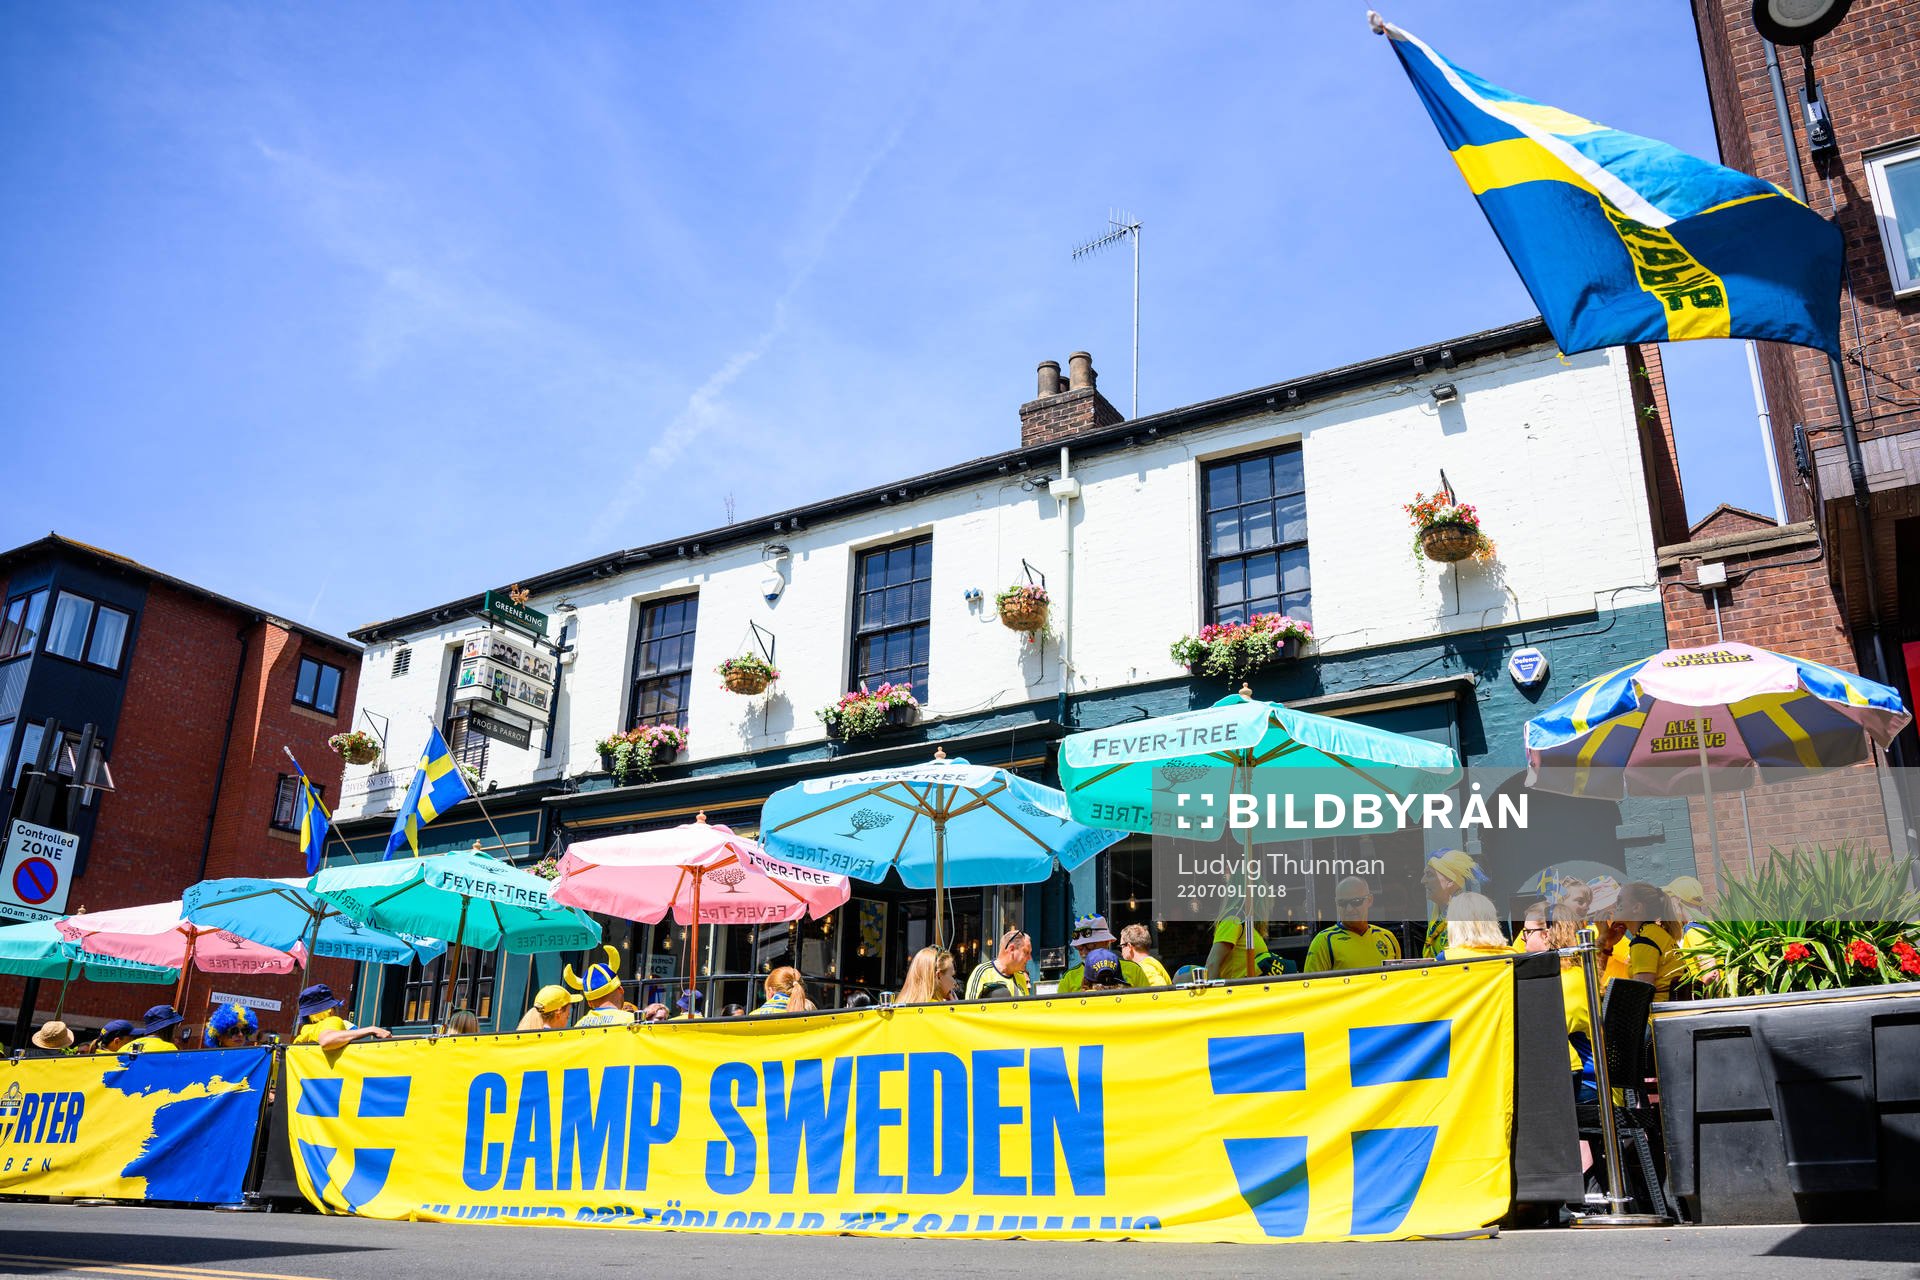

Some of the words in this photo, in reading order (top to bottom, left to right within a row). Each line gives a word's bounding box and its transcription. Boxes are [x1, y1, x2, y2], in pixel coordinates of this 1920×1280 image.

[495, 601, 523, 619] GREENE
[524, 613, 543, 628] KING
[472, 717, 492, 730] FROG
[499, 727, 526, 743] PARROT
[1093, 723, 1239, 759] FEVER-TREE
[829, 772, 969, 790] FEVER-TREE
[17, 824, 74, 848] Controlled
[21, 840, 63, 861] ZONE
[443, 871, 548, 905] FEVER-TREE
[462, 1064, 682, 1192] CAMP
[705, 1045, 1106, 1196] SWEDEN
